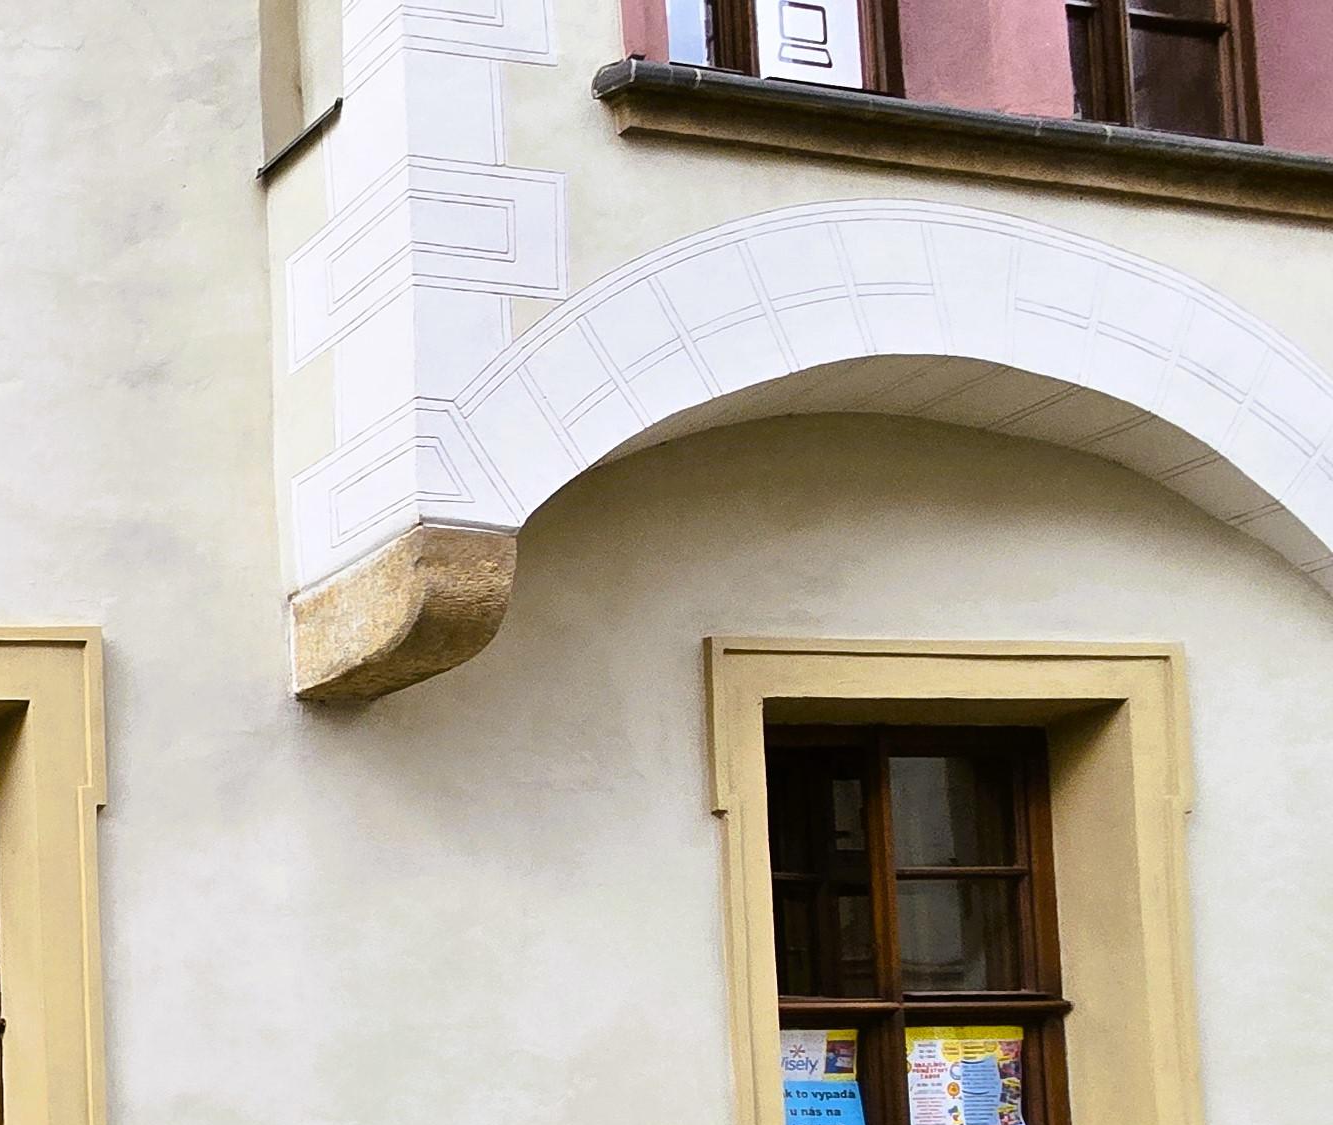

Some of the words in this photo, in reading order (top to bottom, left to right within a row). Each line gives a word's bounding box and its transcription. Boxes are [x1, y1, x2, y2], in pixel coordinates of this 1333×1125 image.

[796, 1089, 809, 1099] to
[811, 1088, 856, 1101] vypadá
[789, 1108, 798, 1117] u
[801, 1105, 823, 1117] nás
[826, 1108, 842, 1117] na
